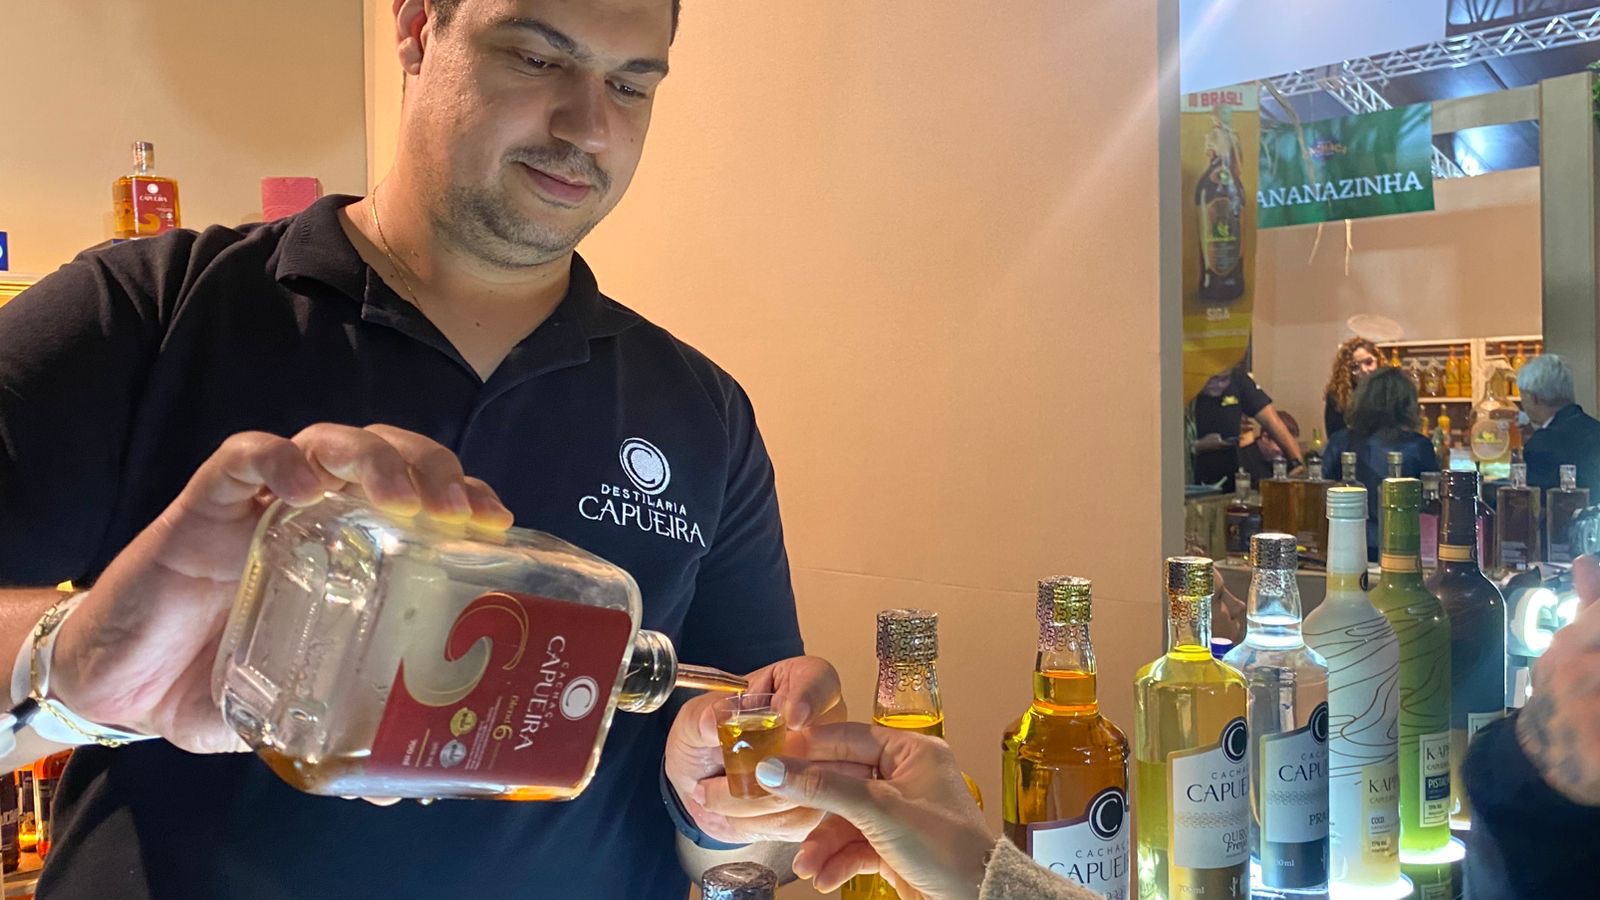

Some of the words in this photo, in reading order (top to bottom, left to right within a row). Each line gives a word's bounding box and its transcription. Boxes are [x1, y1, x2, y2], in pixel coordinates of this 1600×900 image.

[1257, 171, 1424, 209] ANANAZINHA
[601, 483, 687, 516] DESTILARIA
[578, 495, 706, 548] CAPUEIRA
[514, 635, 566, 751] CAPUEIRA
[492, 723, 514, 741] 6
